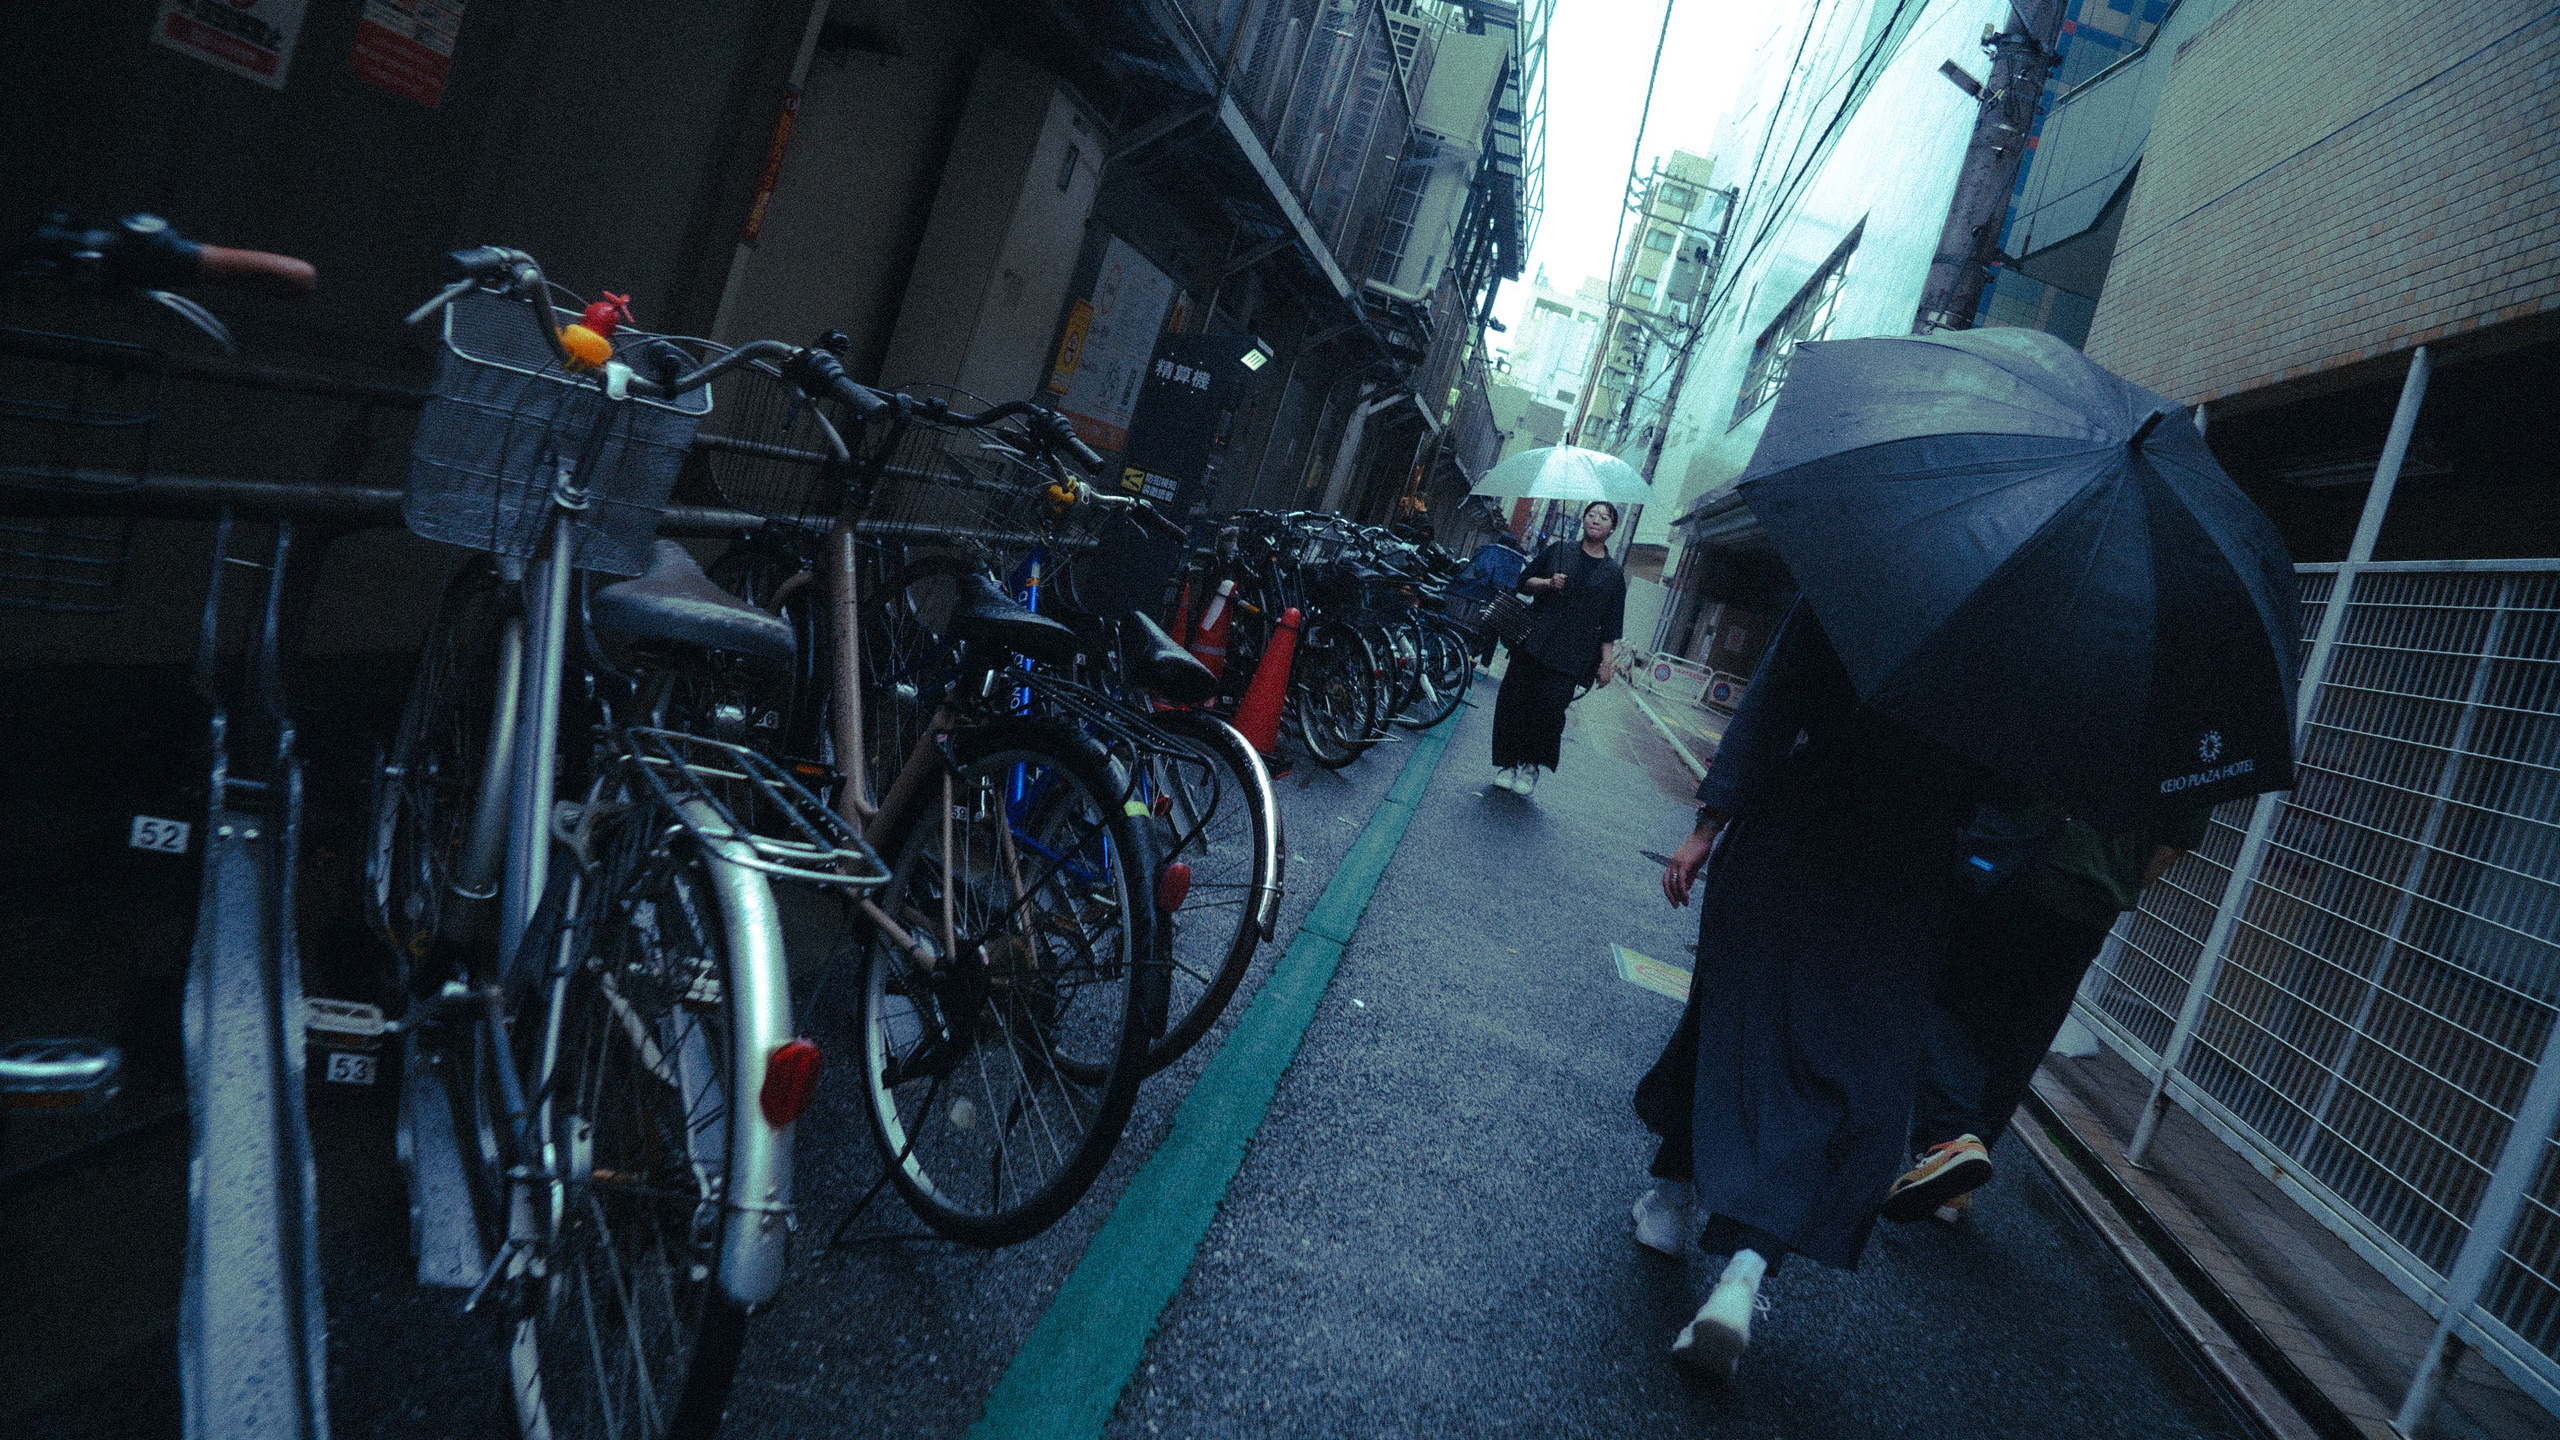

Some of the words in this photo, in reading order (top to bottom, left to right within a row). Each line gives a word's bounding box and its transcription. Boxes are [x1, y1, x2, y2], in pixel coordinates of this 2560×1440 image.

[1155, 359, 1211, 391] 精算機
[2160, 776, 2187, 794] KEIO
[2188, 769, 2221, 788] PLAZA
[2222, 758, 2255, 779] HOTEL
[140, 820, 181, 849] 52
[334, 1057, 369, 1080] 53
